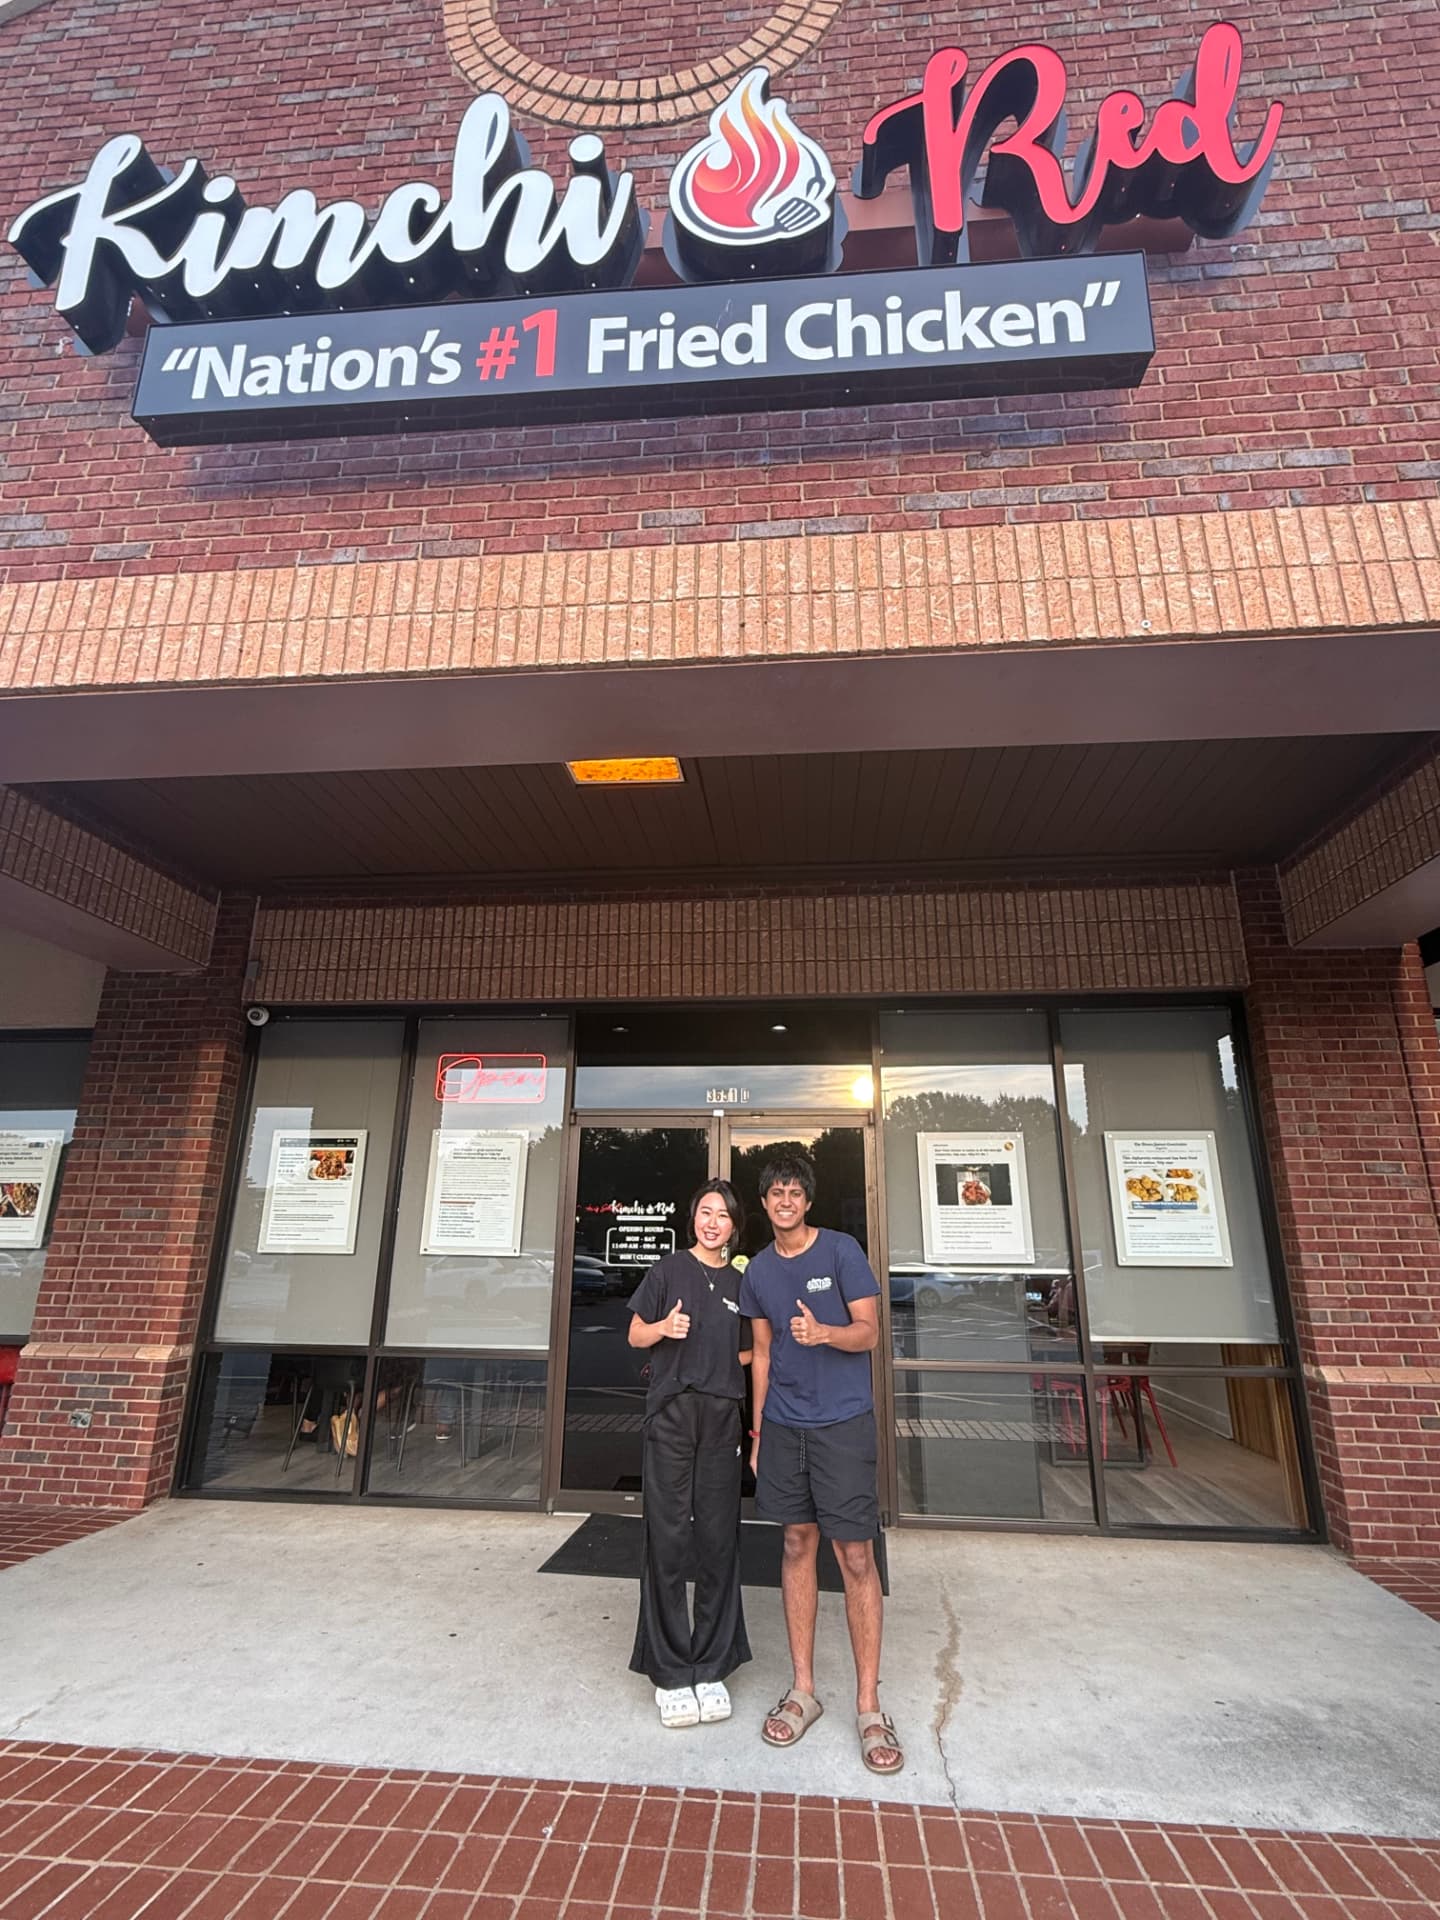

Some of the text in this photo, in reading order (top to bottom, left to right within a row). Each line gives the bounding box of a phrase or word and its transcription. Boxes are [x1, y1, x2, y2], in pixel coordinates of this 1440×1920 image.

[8, 21, 1285, 312] Kimchi Red
[160, 279, 1121, 400] "Nation's #1 Fried Chicken"
[610, 1199, 646, 1215] Kimchi
